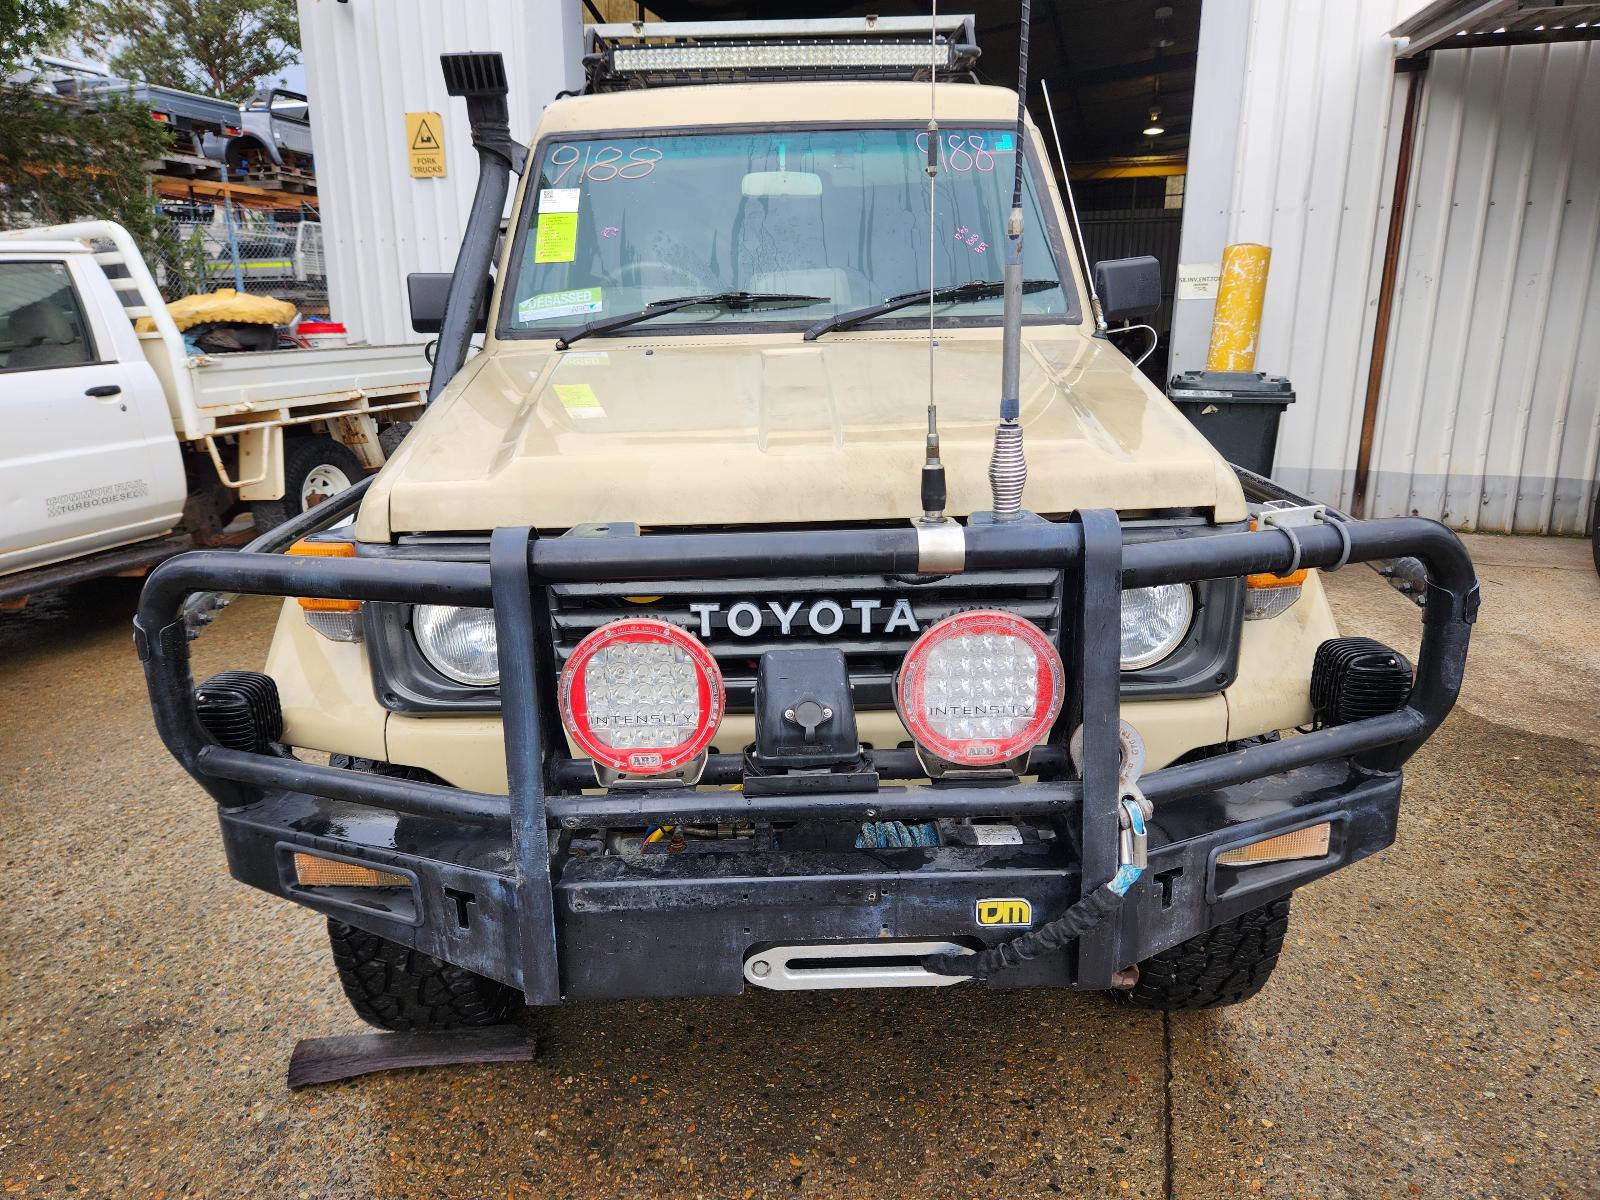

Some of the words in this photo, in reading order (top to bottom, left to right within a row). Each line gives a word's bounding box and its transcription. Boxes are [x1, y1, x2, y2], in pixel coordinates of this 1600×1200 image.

[413, 165, 443, 174] TRUCKS
[416, 157, 437, 165] FORK
[551, 145, 663, 185] 9188
[528, 290, 592, 308] DEGASSED
[46, 485, 113, 506] COMMON
[61, 499, 99, 513] TURBO
[102, 490, 140, 504] DIESEL
[689, 598, 921, 637] TOYOTA
[590, 712, 693, 725] INTENSITY
[930, 704, 1033, 716] INTENSITY
